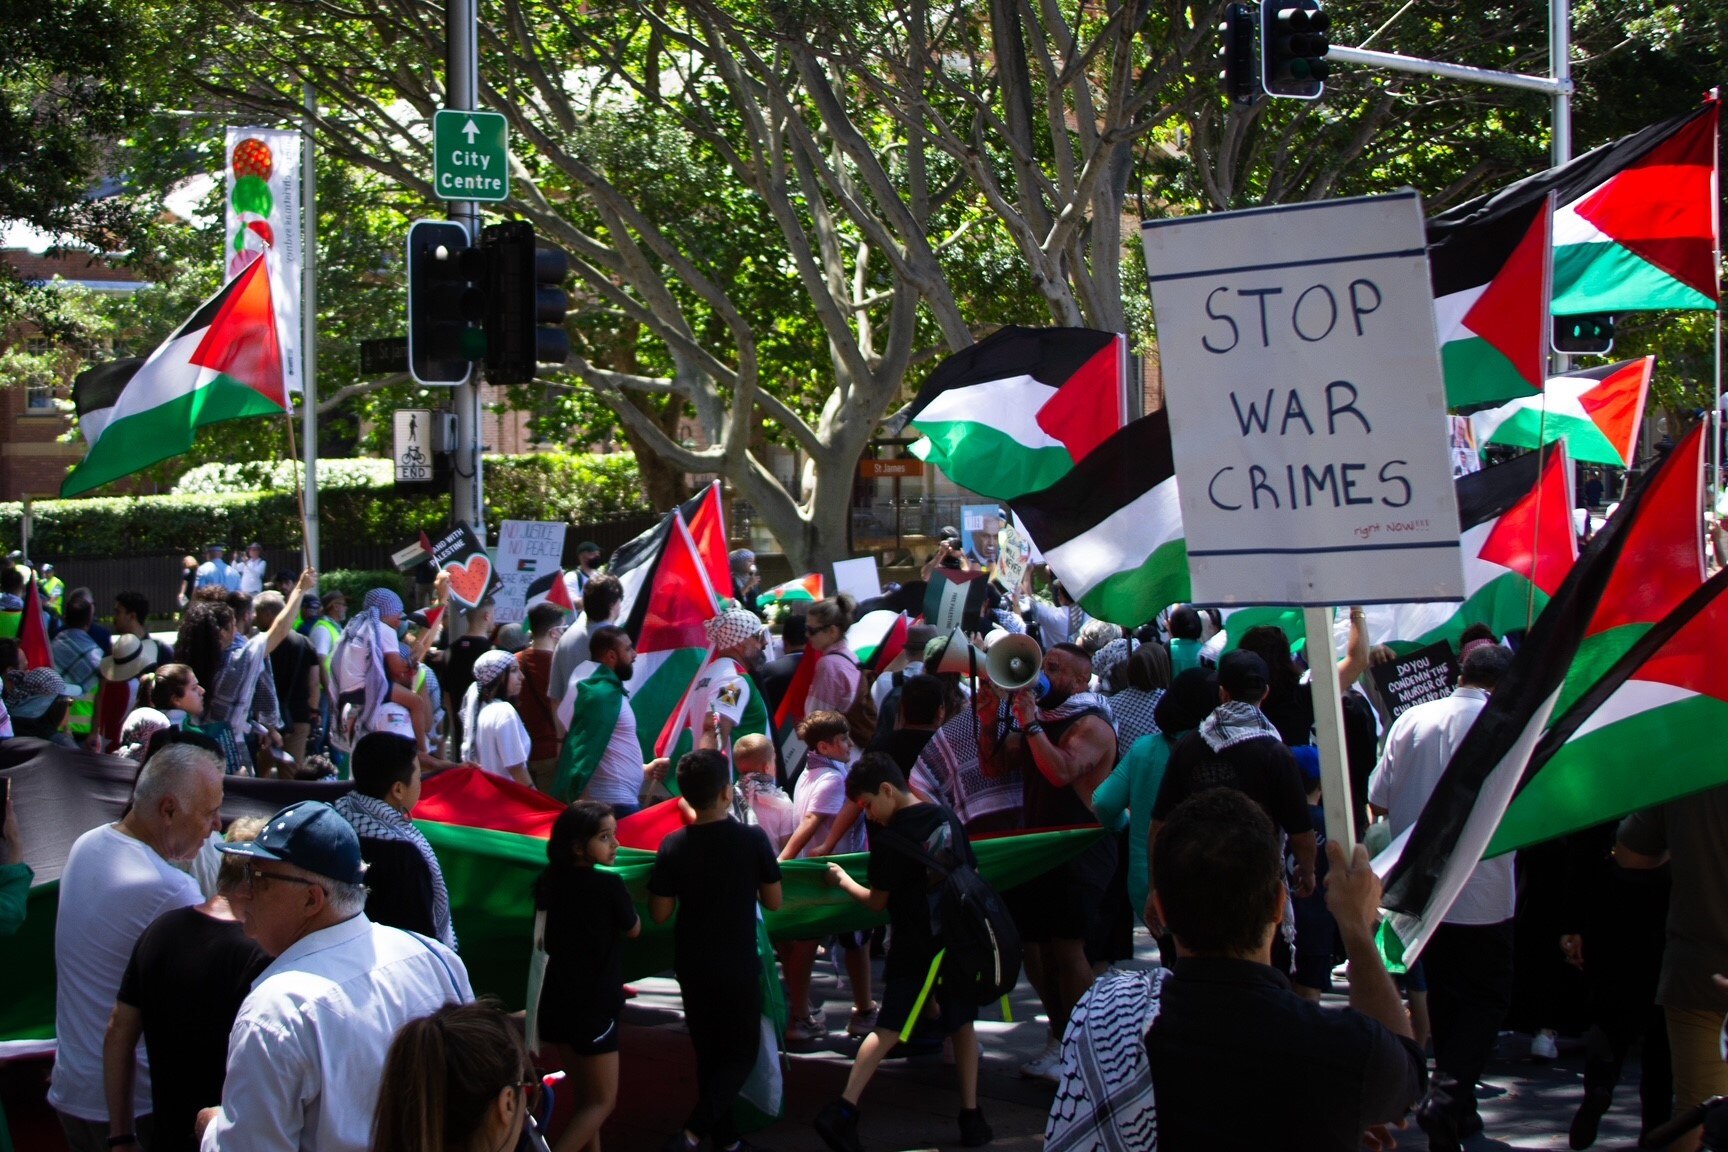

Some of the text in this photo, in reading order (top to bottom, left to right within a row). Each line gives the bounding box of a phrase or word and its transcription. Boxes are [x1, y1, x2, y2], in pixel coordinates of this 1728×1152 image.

[452, 150, 490, 170] City
[441, 172, 501, 190] Centre
[1202, 278, 1382, 354] STOP
[1229, 380, 1372, 437] WAR
[402, 467, 426, 478] END
[874, 463, 906, 473] St James
[1208, 460, 1412, 511] CRIMES
[445, 528, 465, 544] WITH
[520, 523, 558, 541] JUSTICE
[1354, 522, 1380, 539] right
[429, 540, 466, 567] PALESTINE
[508, 540, 523, 555] NO
[1396, 656, 1430, 677] DO YOU
[1388, 662, 1449, 693] CONDEMN THE
[1398, 674, 1448, 702] MURDER OF
[1438, 688, 1452, 699] OR
